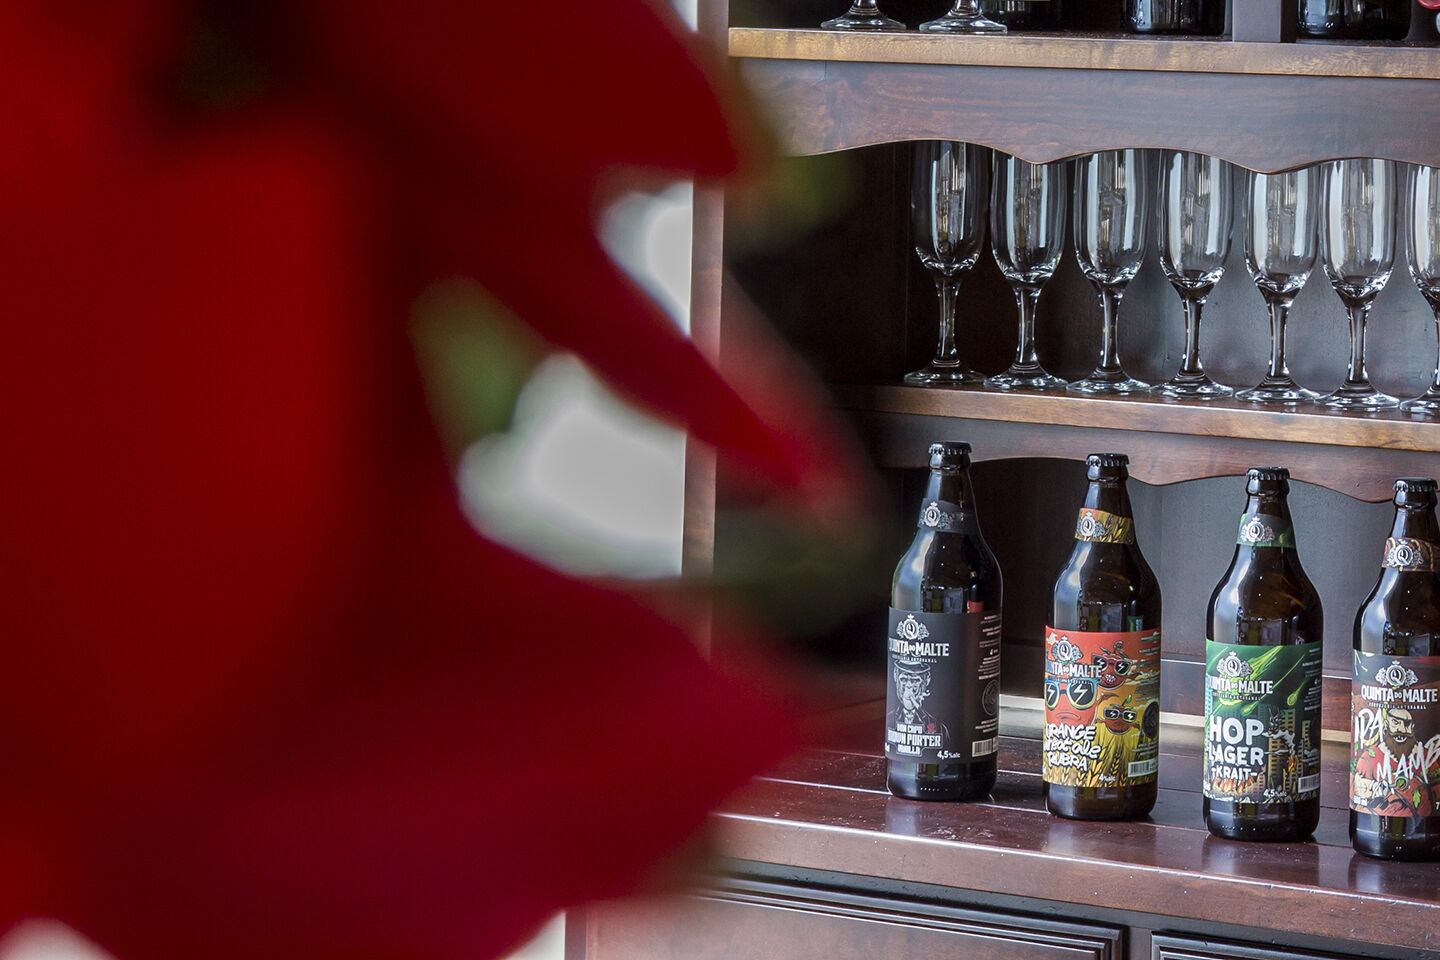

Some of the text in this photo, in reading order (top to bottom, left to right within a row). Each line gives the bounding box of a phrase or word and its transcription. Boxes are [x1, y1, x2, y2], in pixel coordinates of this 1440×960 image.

[909, 644, 916, 652] DO
[916, 642, 950, 657] MALTE
[1070, 664, 1102, 678] MALTE
[1239, 680, 1274, 695] MALTE
[1361, 685, 1439, 703] QUINTA DO MALTE
[1209, 714, 1265, 746] HOP
[1354, 708, 1385, 756] IPA
[907, 735, 941, 747] PORTER
[1072, 740, 1102, 759] ale
[1047, 751, 1089, 772] RUBRA
[1208, 742, 1265, 766] LAGER
